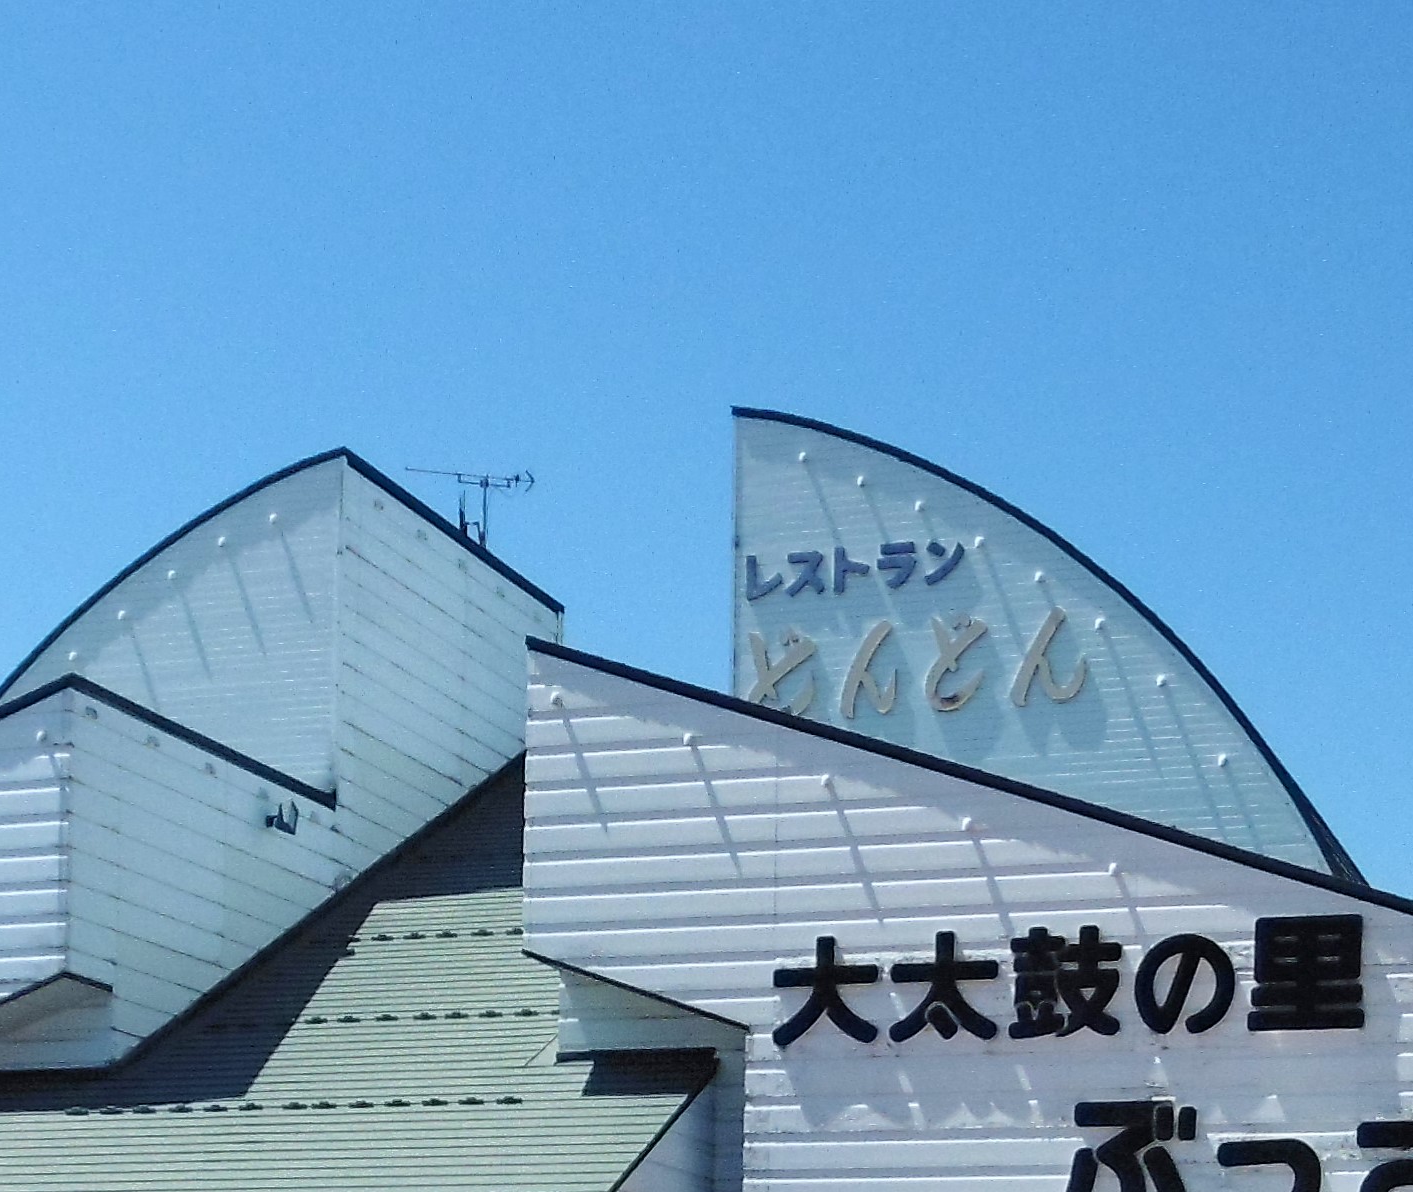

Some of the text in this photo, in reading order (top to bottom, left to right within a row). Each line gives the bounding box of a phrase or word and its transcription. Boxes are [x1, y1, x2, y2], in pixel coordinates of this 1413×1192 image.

[745, 540, 966, 602] レストラン
[747, 605, 1088, 720] どんどん
[773, 913, 1365, 1046] 大太鼓の里
